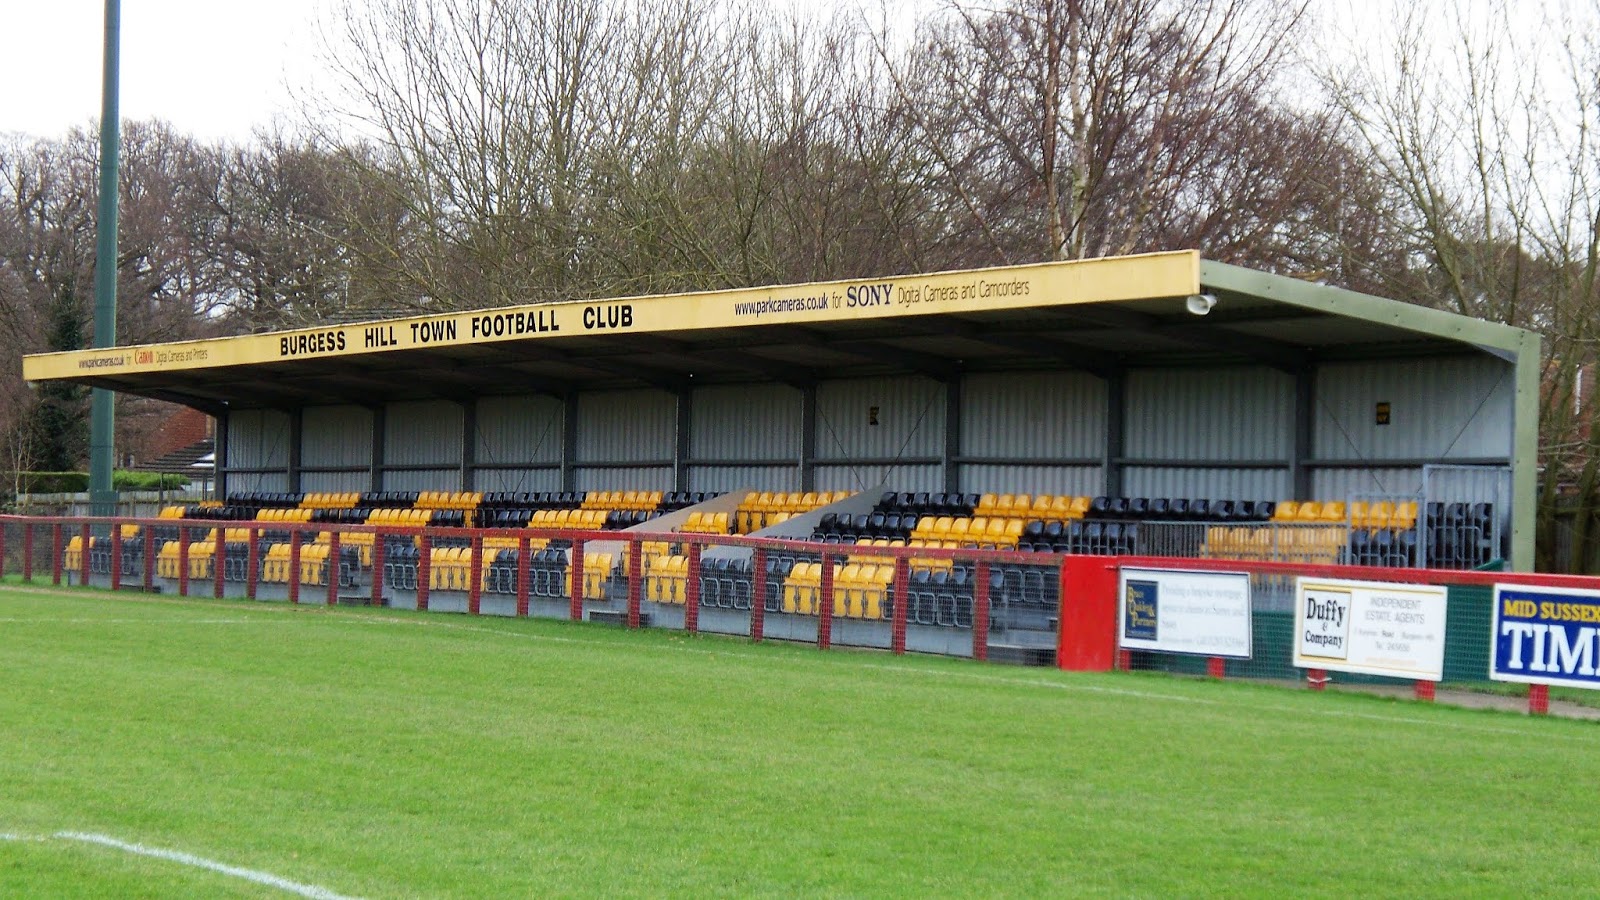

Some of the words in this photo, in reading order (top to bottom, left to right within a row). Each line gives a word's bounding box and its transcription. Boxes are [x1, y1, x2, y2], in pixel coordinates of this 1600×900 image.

[734, 292, 828, 318] www.parkcameras.co.uk
[832, 291, 842, 309] for
[846, 283, 893, 308] SONY
[898, 286, 921, 308] Digital
[924, 283, 959, 303] Cameras
[961, 280, 976, 300] and
[979, 276, 1030, 299] Camcorders
[280, 330, 346, 356] BURGESS
[365, 326, 397, 348] HILL
[410, 319, 457, 343] TOWN
[471, 309, 559, 338] FOOTBALL
[583, 304, 633, 329] CLUB
[134, 349, 154, 365] Canon
[1306, 597, 1346, 628] Duffy
[1370, 596, 1422, 610] INDEPENDENT
[1503, 599, 1537, 618] MID
[1540, 602, 1600, 623] SUSSEX
[1365, 610, 1392, 623] ESTATE
[1394, 613, 1425, 625] AGENTS
[1305, 630, 1344, 649] Company
[1502, 621, 1600, 677] TIM
